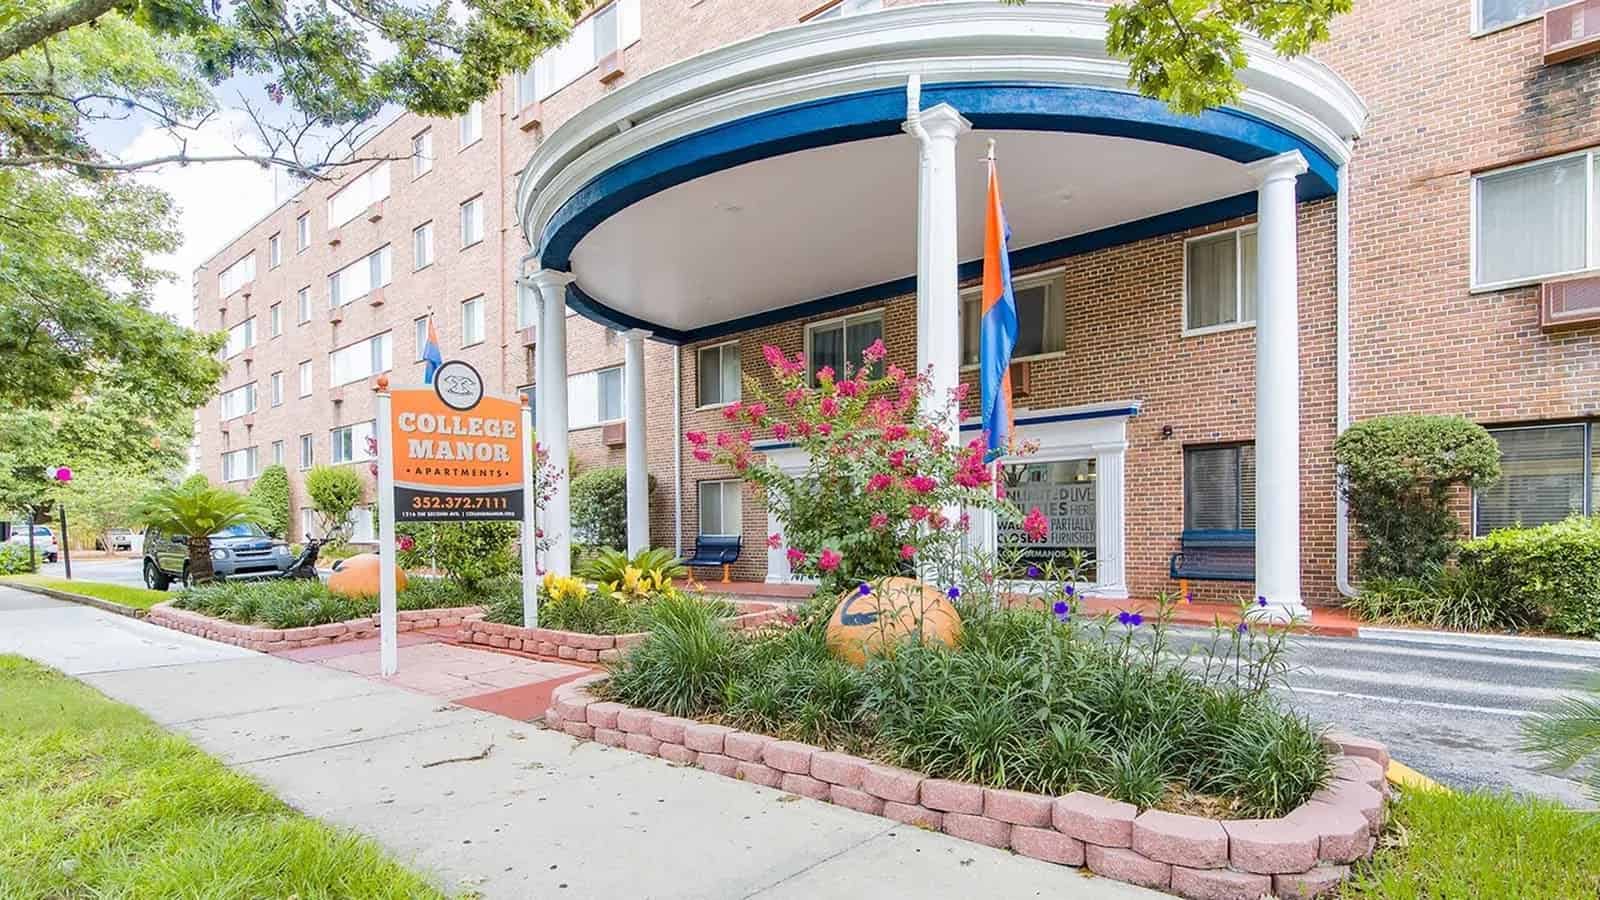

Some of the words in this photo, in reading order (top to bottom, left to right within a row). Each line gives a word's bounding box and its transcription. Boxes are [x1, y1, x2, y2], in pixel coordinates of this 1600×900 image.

[398, 411, 517, 439] COLLEGE
[408, 439, 511, 463] MANOR
[415, 467, 502, 477] APARTMENTS
[412, 496, 508, 509] 352.372.7111
[1051, 518, 1096, 532] PARTIALLY
[1051, 532, 1096, 545] FURNISHED
